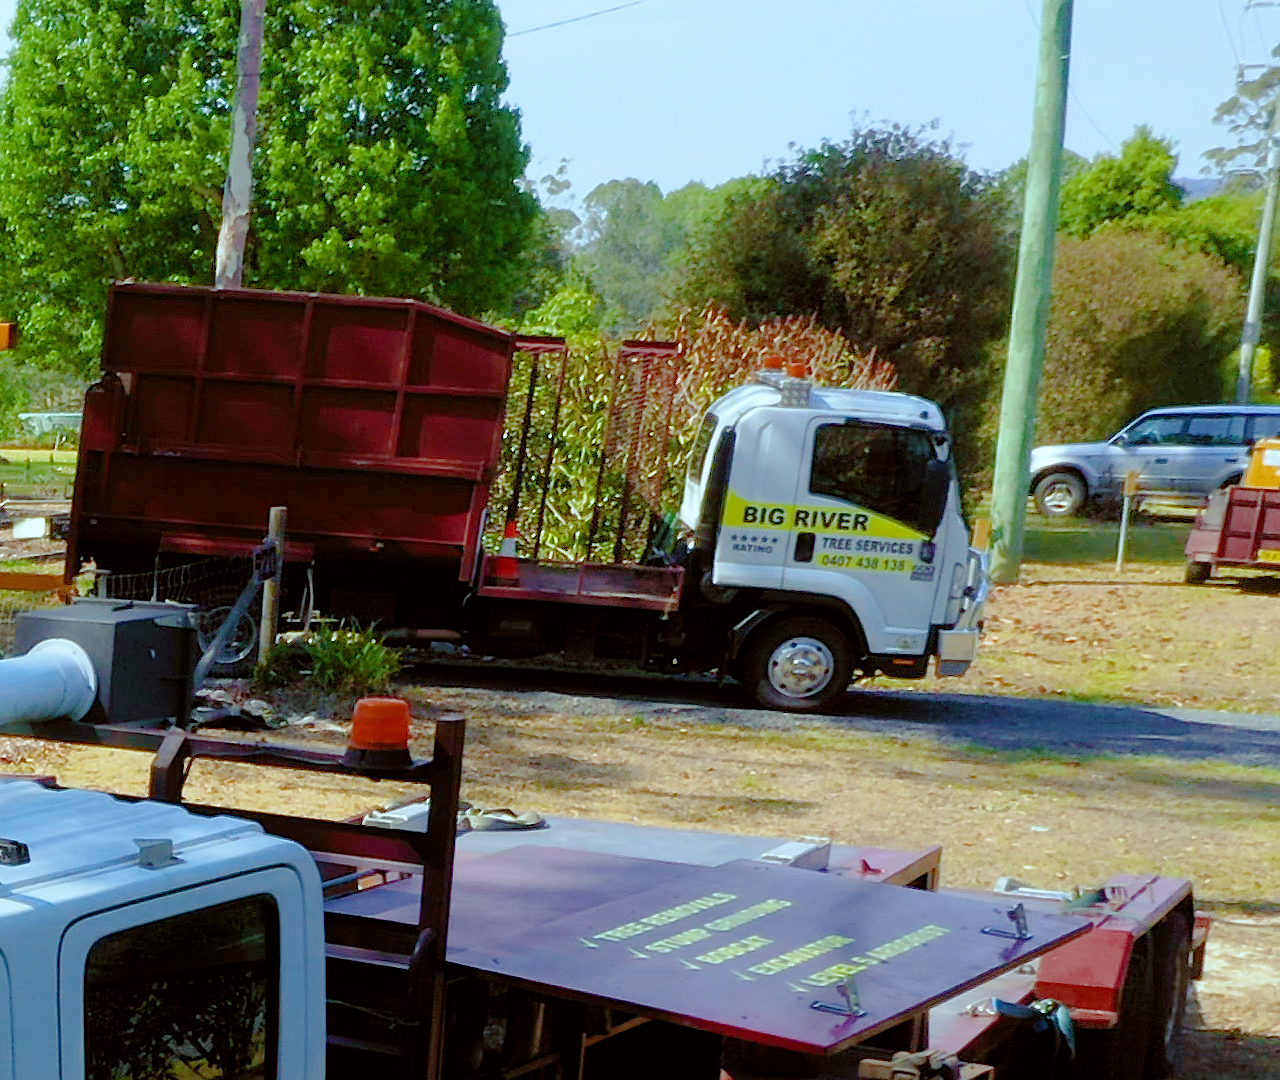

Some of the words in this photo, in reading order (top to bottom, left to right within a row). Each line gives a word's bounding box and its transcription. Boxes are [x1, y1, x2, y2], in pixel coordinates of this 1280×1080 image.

[743, 506, 784, 525] BIG
[793, 510, 868, 531] RIVER
[821, 537, 853, 551] TREE
[855, 539, 913, 554] SERVICES
[820, 554, 853, 567] 0407
[855, 557, 882, 570] 438
[884, 559, 905, 571] 138
[592, 922, 655, 942] TREE
[644, 928, 712, 953] STUMP
[695, 935, 774, 965] BOBCAT
